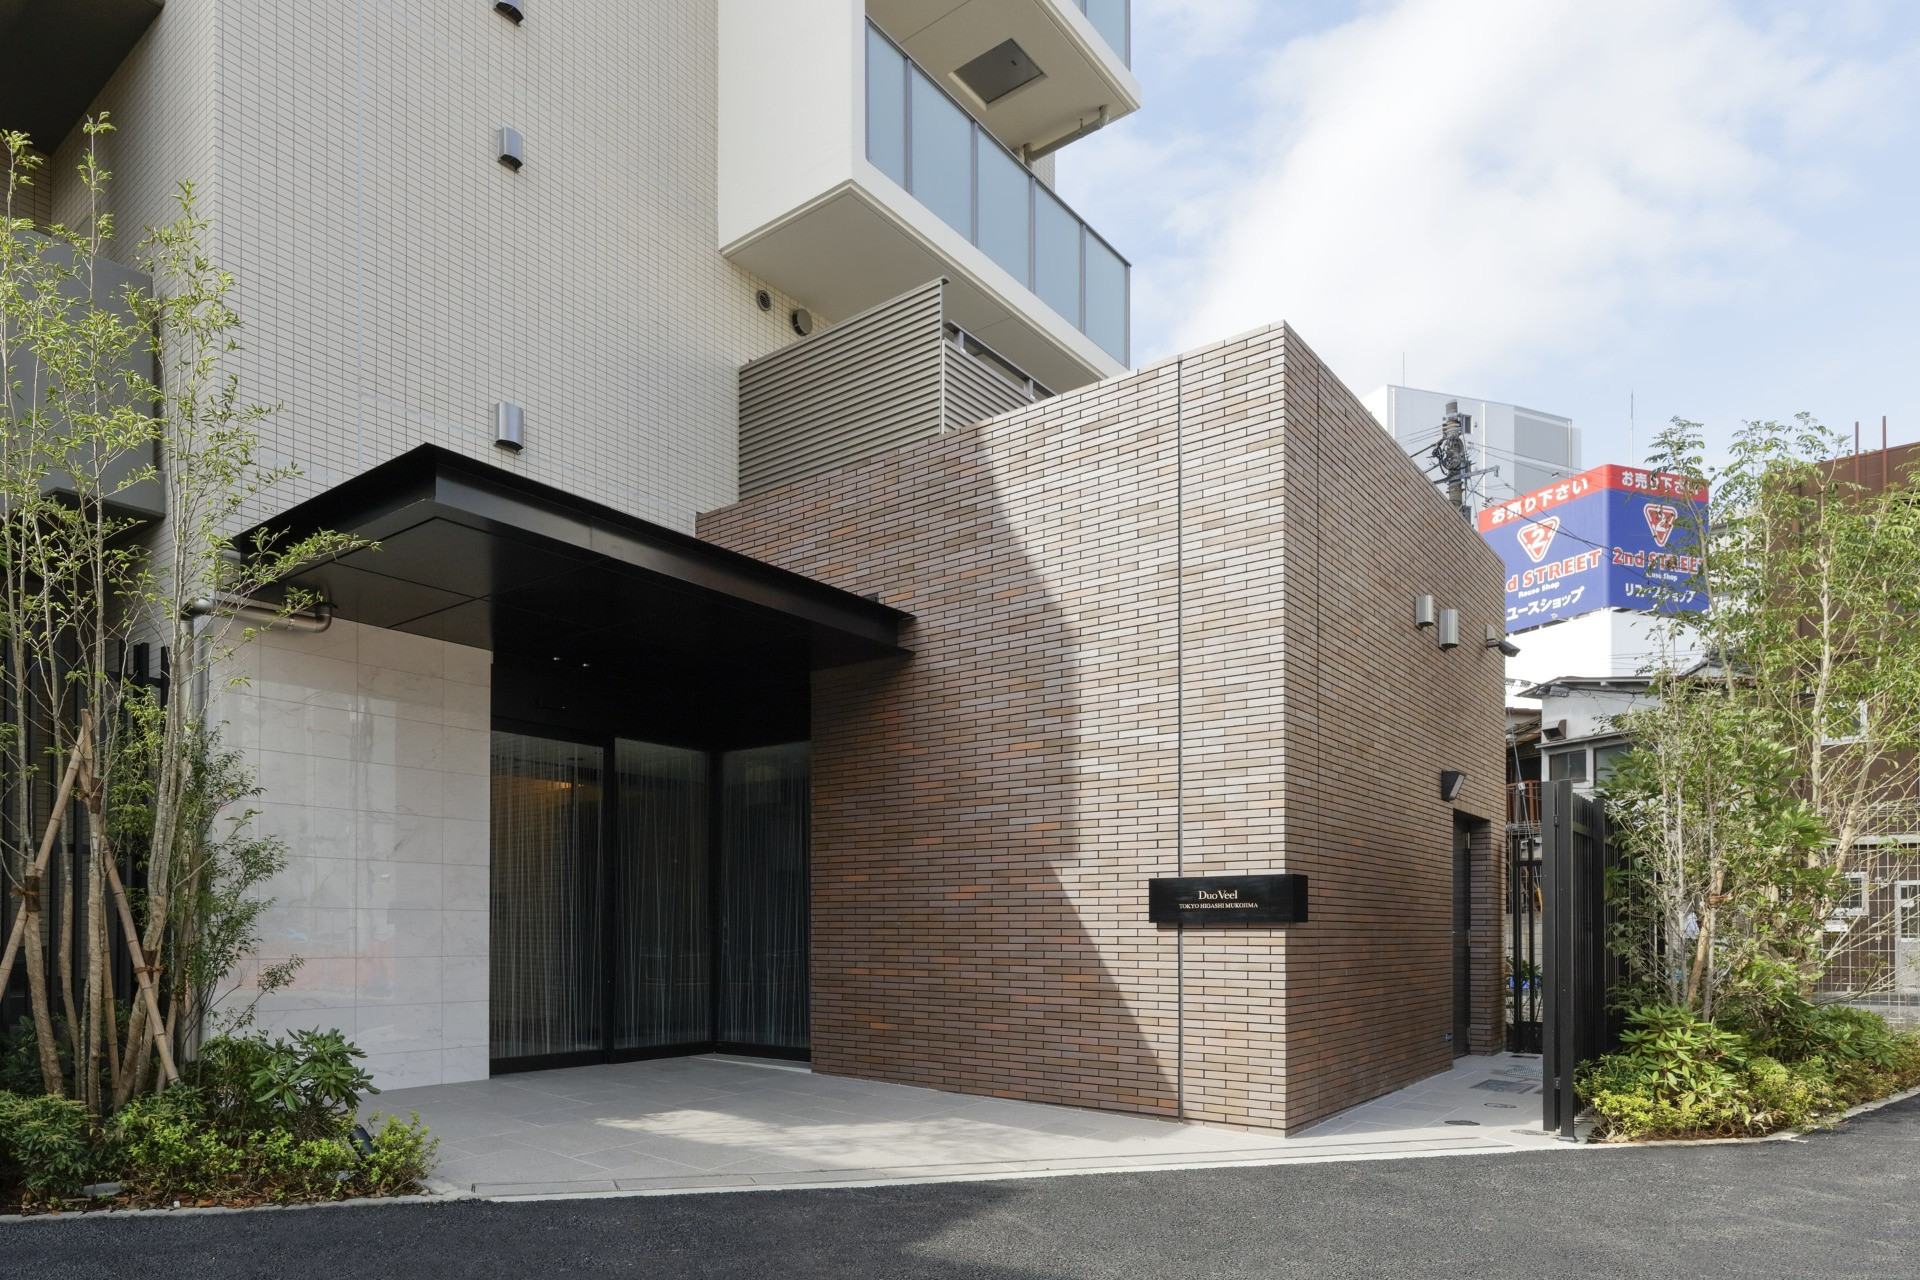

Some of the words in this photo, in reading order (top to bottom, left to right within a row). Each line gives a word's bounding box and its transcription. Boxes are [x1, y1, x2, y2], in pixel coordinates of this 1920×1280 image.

[1491, 478, 1588, 524] お売り下さい
[1522, 548, 1603, 588] STREET
[1612, 547, 1645, 568] 2nd
[1648, 551, 1704, 575] STEE
[1663, 572, 1678, 582] Shop
[1518, 587, 1540, 598] Reuse
[1541, 581, 1560, 592] Shop
[1198, 890, 1218, 900] Duo
[1218, 889, 1238, 899] Veel
